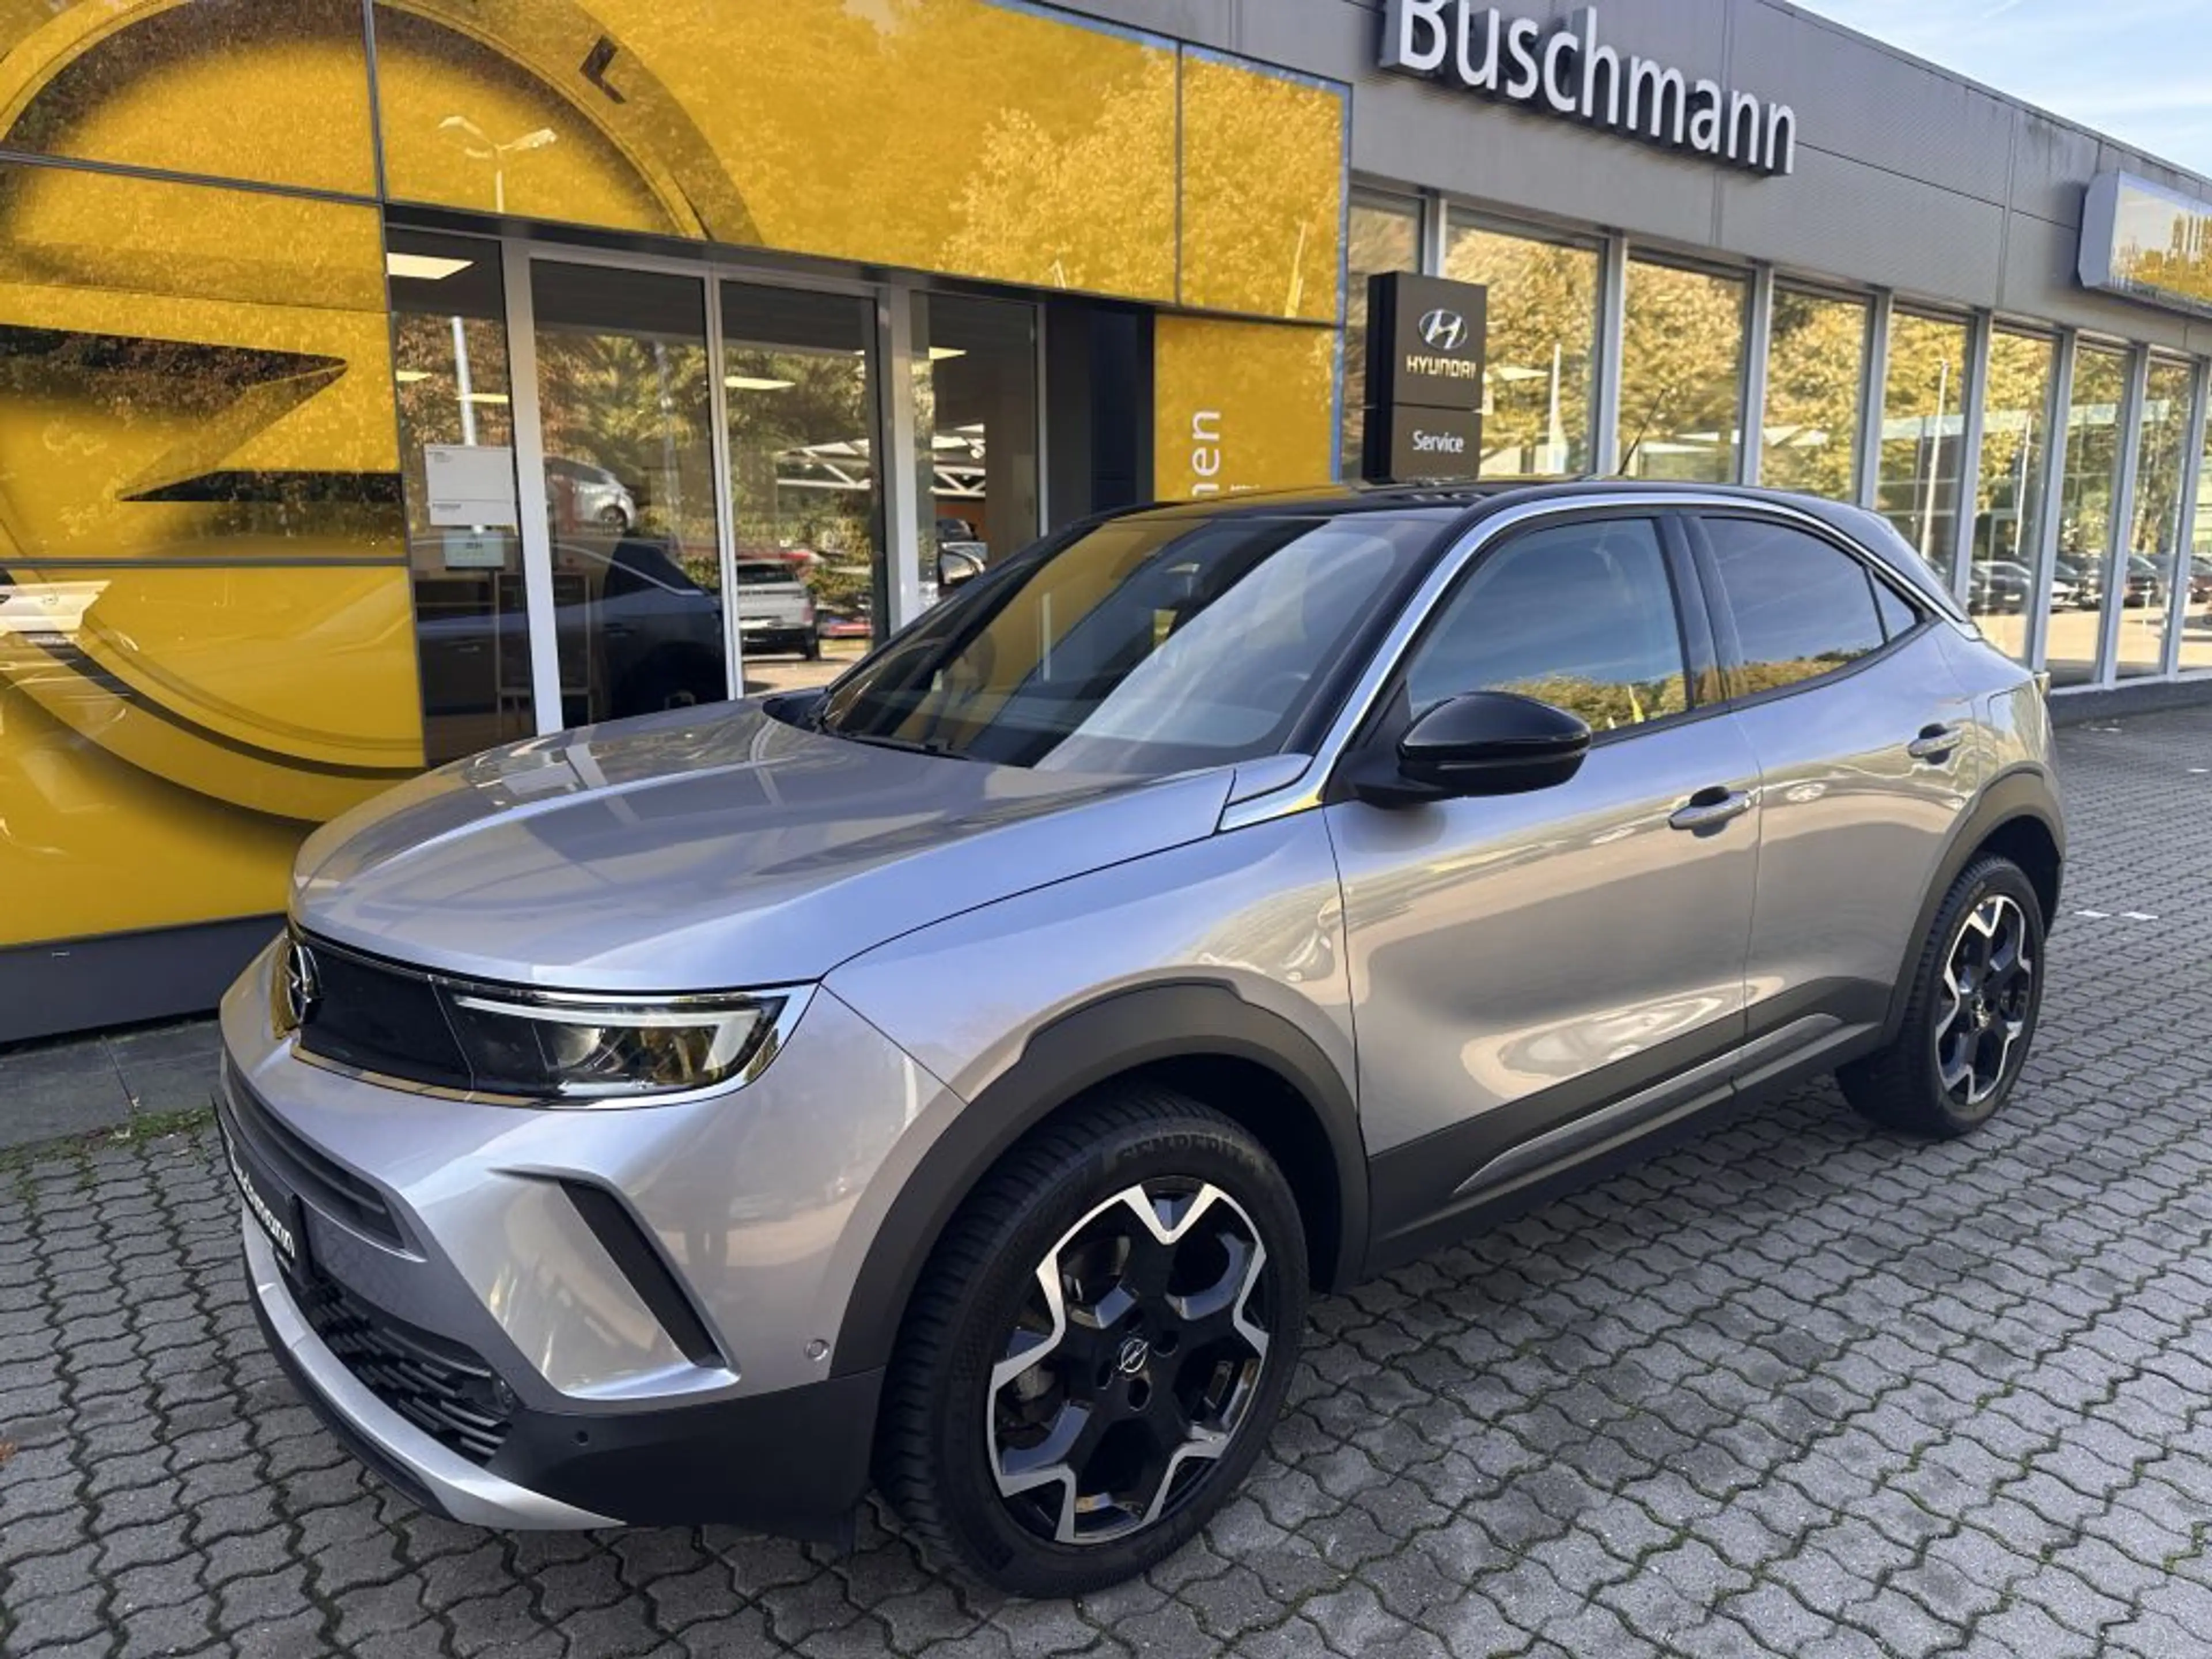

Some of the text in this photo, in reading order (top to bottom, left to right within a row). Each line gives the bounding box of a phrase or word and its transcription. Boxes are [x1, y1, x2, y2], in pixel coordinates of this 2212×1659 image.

[1396, 0, 1797, 175] Buschmann
[1406, 354, 1476, 379] HYUNDAI
[1412, 431, 1465, 453] Service
